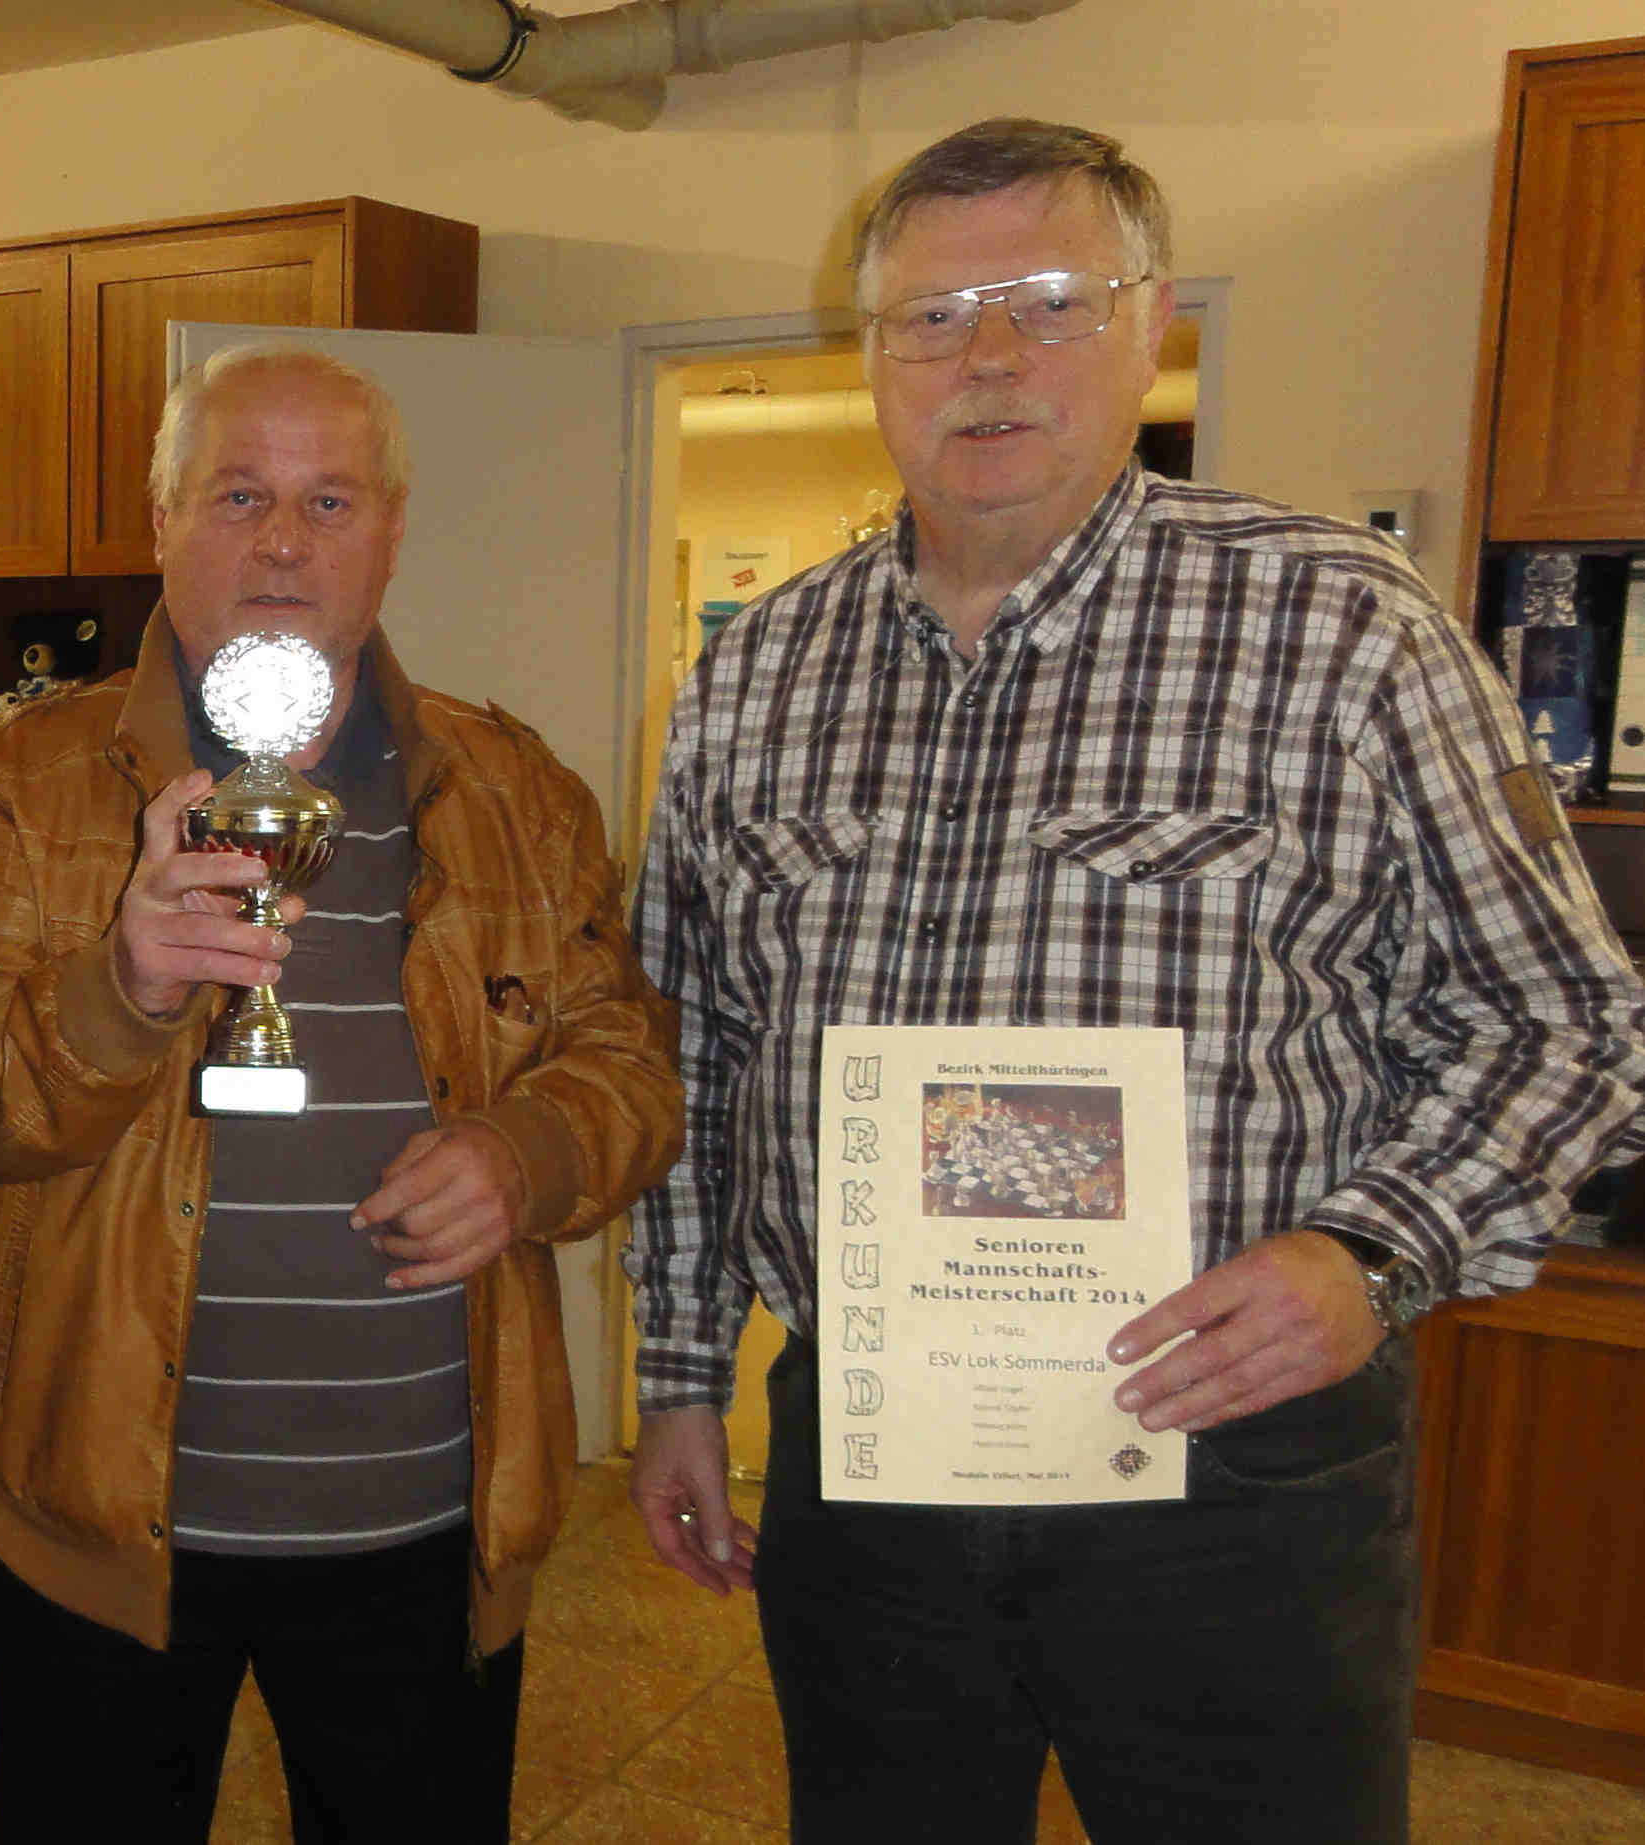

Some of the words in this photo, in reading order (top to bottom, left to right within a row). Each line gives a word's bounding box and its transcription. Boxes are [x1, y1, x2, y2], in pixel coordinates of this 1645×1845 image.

[937, 1063, 984, 1075] Bezirk
[974, 1237, 1085, 1255] Senioren
[943, 1260, 1107, 1279] Mannschafts-
[910, 1284, 1077, 1303] Meisterschaft
[1089, 1287, 1148, 1305] 2014
[994, 1325, 1027, 1338] Platz
[928, 1351, 962, 1367] ESV
[967, 1352, 999, 1369] Lok
